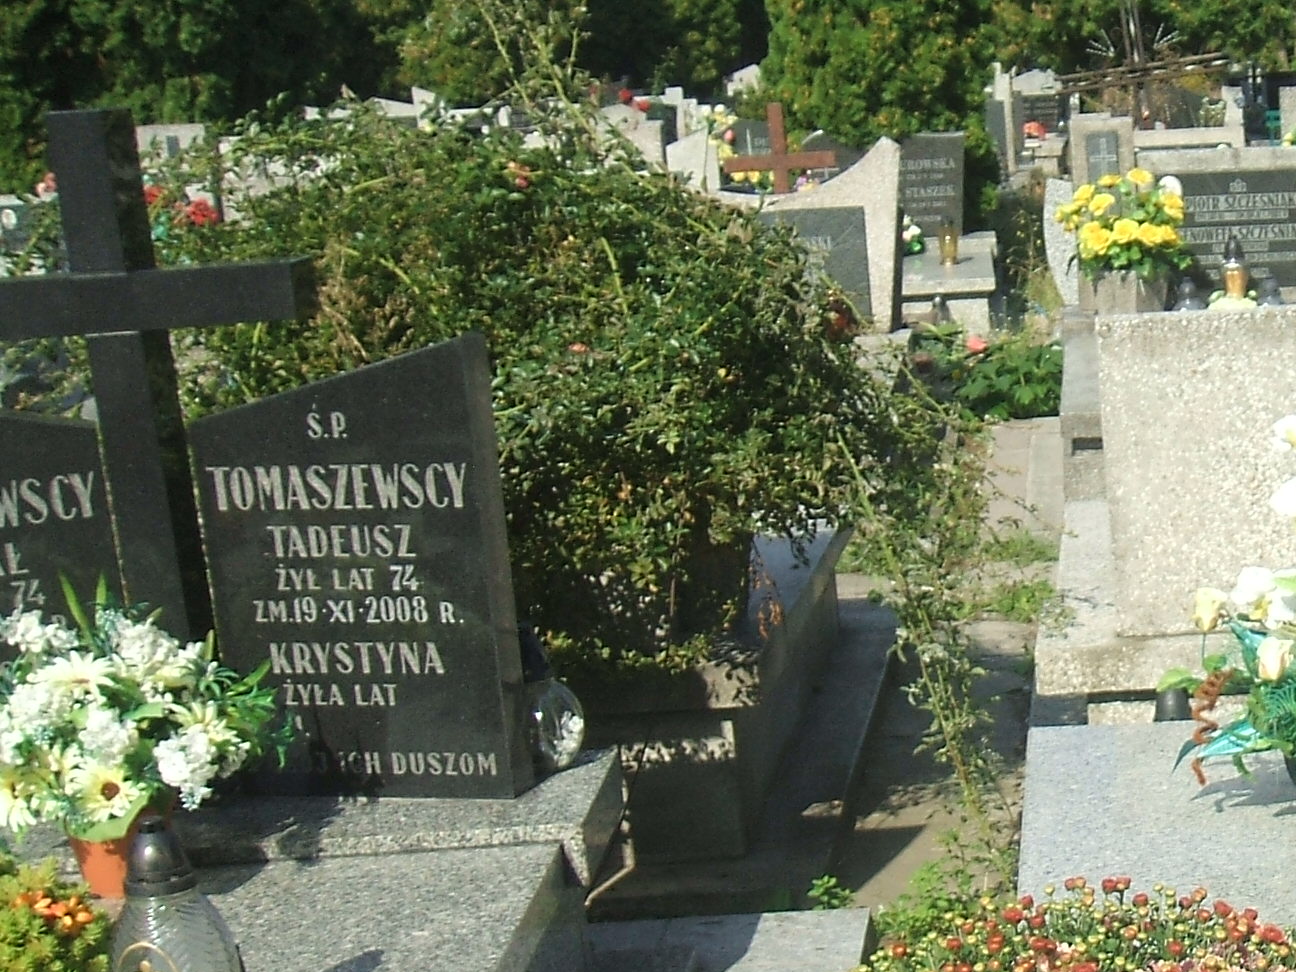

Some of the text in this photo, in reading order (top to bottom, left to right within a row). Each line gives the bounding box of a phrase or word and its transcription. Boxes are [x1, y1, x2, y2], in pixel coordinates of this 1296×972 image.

[0, 471, 94, 528] WSCY
[206, 463, 467, 511] TOMASZEWSCY
[267, 525, 417, 559] TADEUSZ
[334, 568, 375, 591] LAT
[389, 564, 420, 591] 74
[269, 642, 446, 675] KRYSTYNA
[354, 683, 397, 706] LAT
[392, 751, 498, 776] DUSZOM
